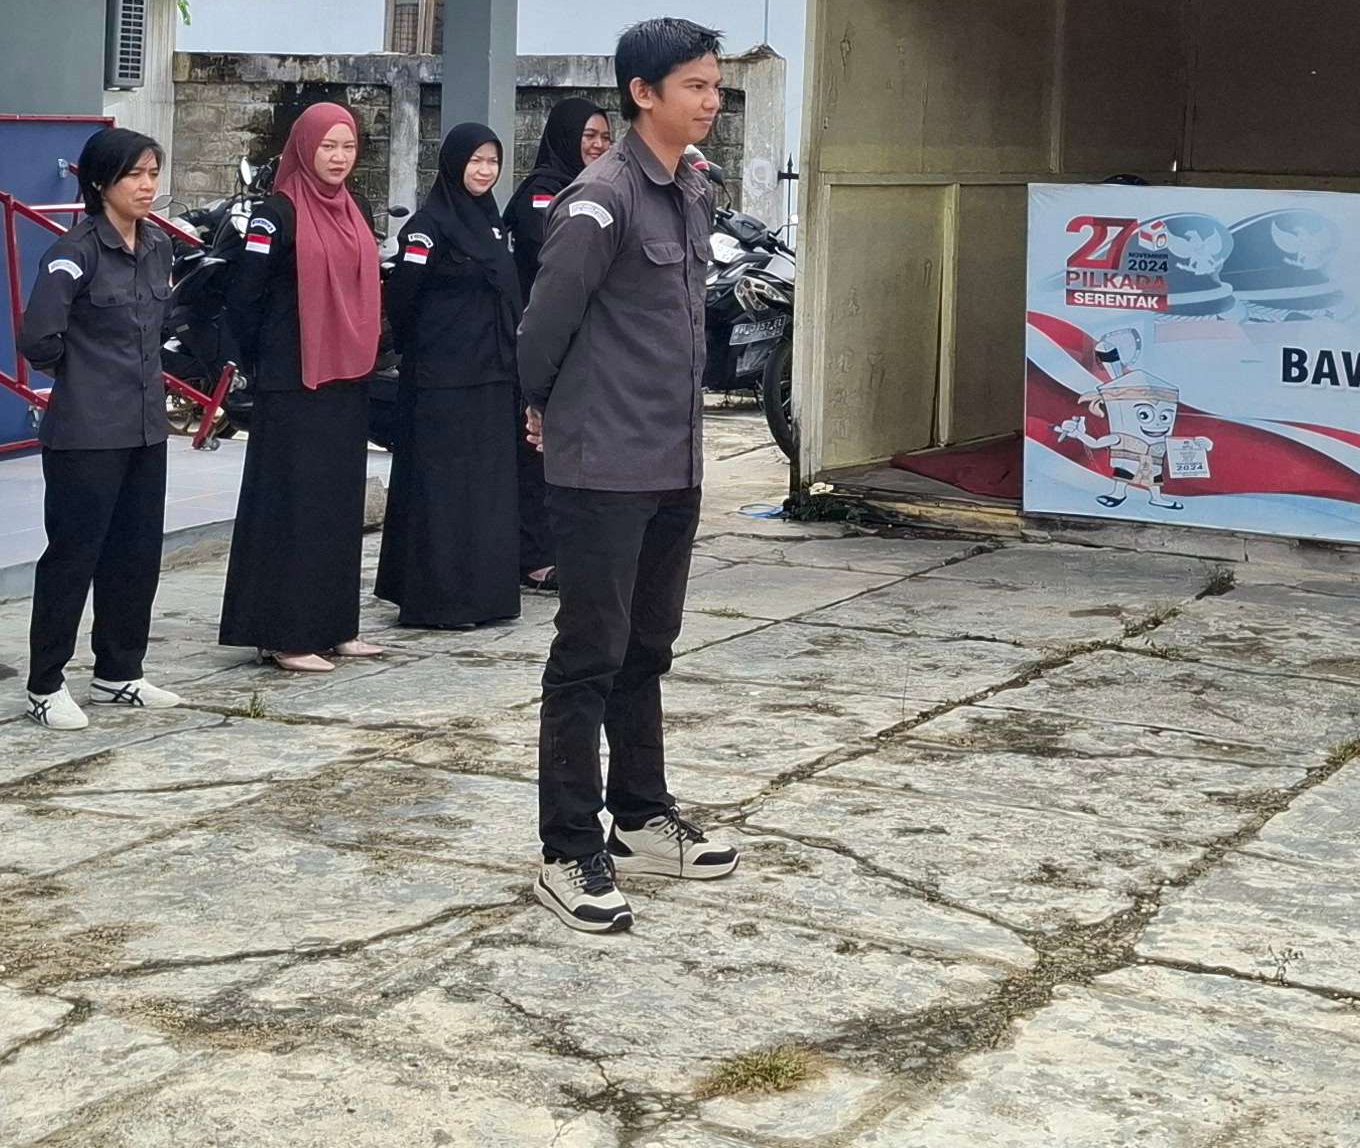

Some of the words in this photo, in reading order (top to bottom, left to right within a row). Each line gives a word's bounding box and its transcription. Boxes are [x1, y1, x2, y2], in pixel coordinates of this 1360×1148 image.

[1065, 215, 1139, 270] 27
[1128, 260, 1168, 272] 2024
[1066, 270, 1167, 290] PILKADA
[1073, 292, 1159, 309] SERENTAK
